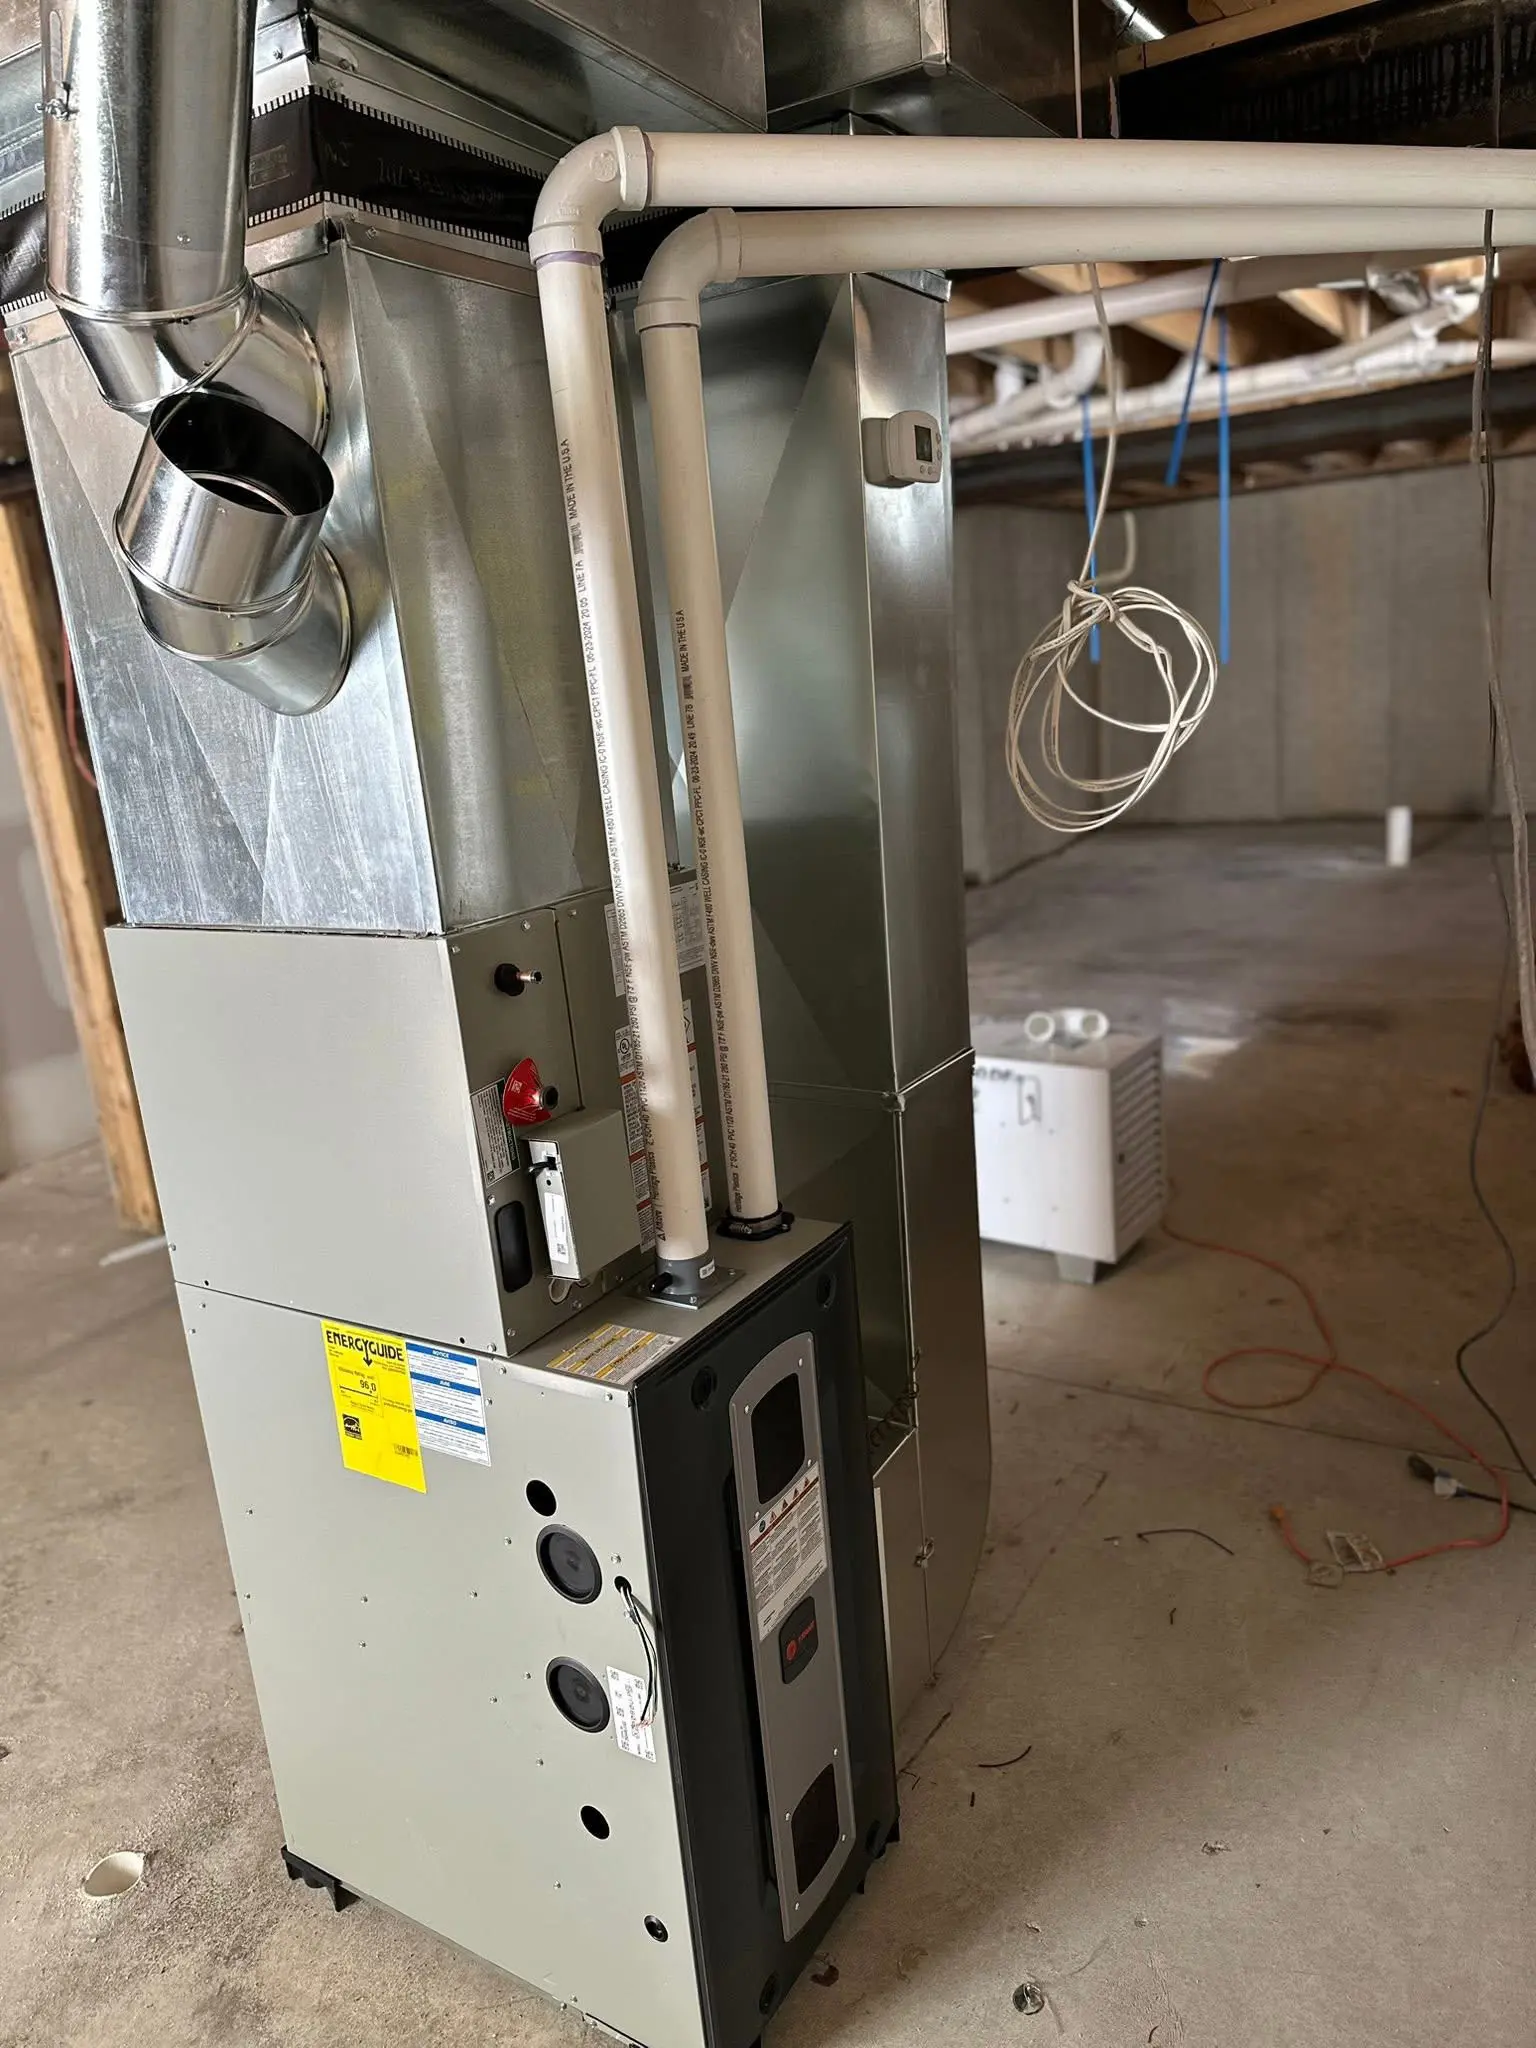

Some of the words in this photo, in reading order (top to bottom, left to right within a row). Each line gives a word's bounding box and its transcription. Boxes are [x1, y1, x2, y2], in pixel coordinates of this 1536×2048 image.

[563, 464, 572, 482] THE
[567, 493, 577, 518] MADE
[679, 629, 687, 642] THE
[681, 652, 689, 671] MADE
[600, 765, 610, 794] CASING
[604, 795, 613, 816] WELL
[609, 836, 617, 857] ASTM
[620, 931, 629, 951] ASTM
[326, 1330, 404, 1362] ENERGYGUIDE
